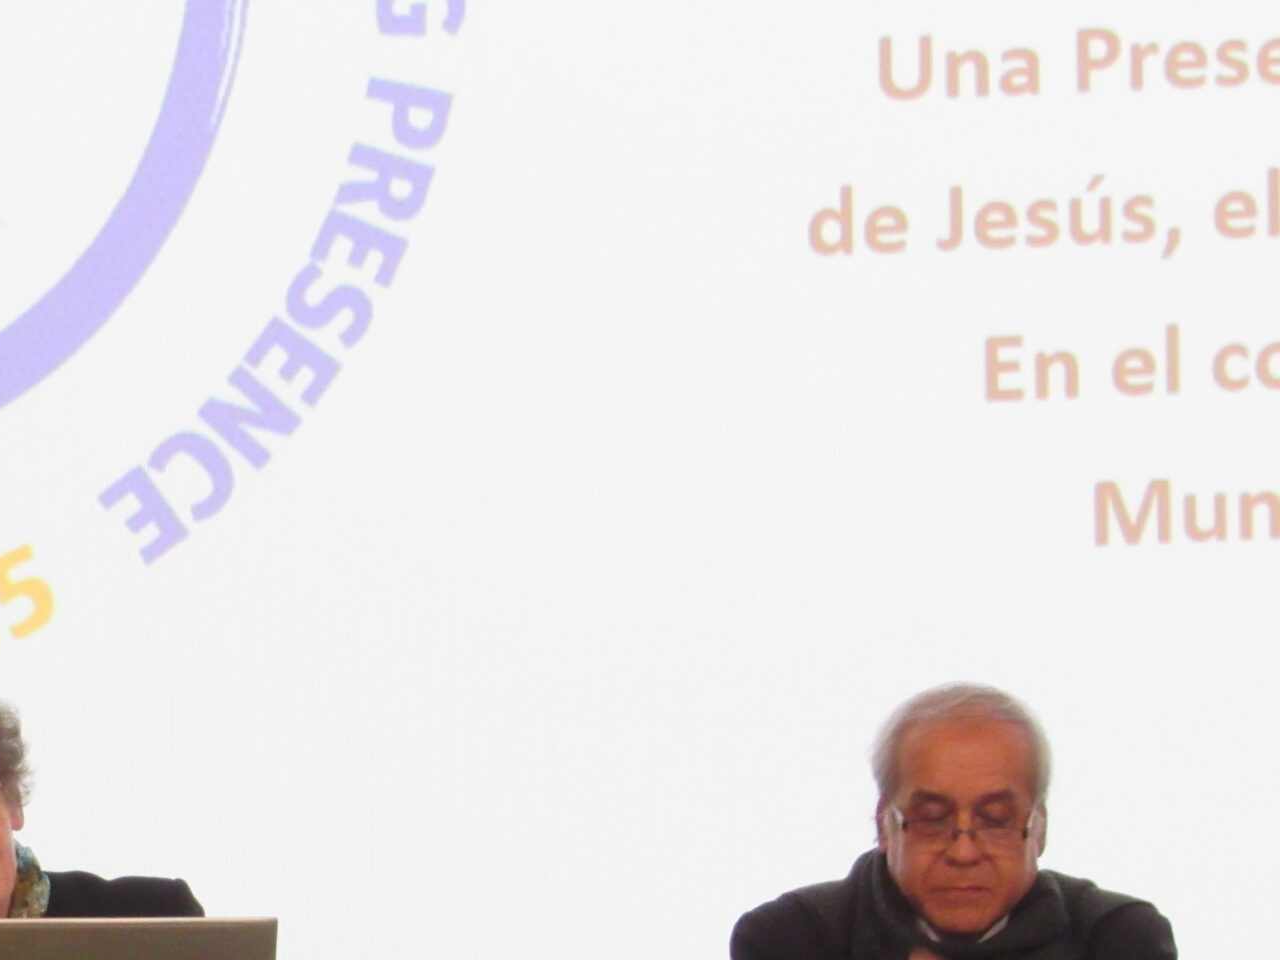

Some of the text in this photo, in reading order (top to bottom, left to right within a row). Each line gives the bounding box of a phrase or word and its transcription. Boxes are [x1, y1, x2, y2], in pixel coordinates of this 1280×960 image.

[878, 34, 1040, 101] Una
[807, 184, 909, 256] de
[935, 173, 1182, 261] Jesús,
[98, 77, 454, 566] PRESENCE
[984, 334, 1081, 403] En
[1111, 323, 1181, 396] el
